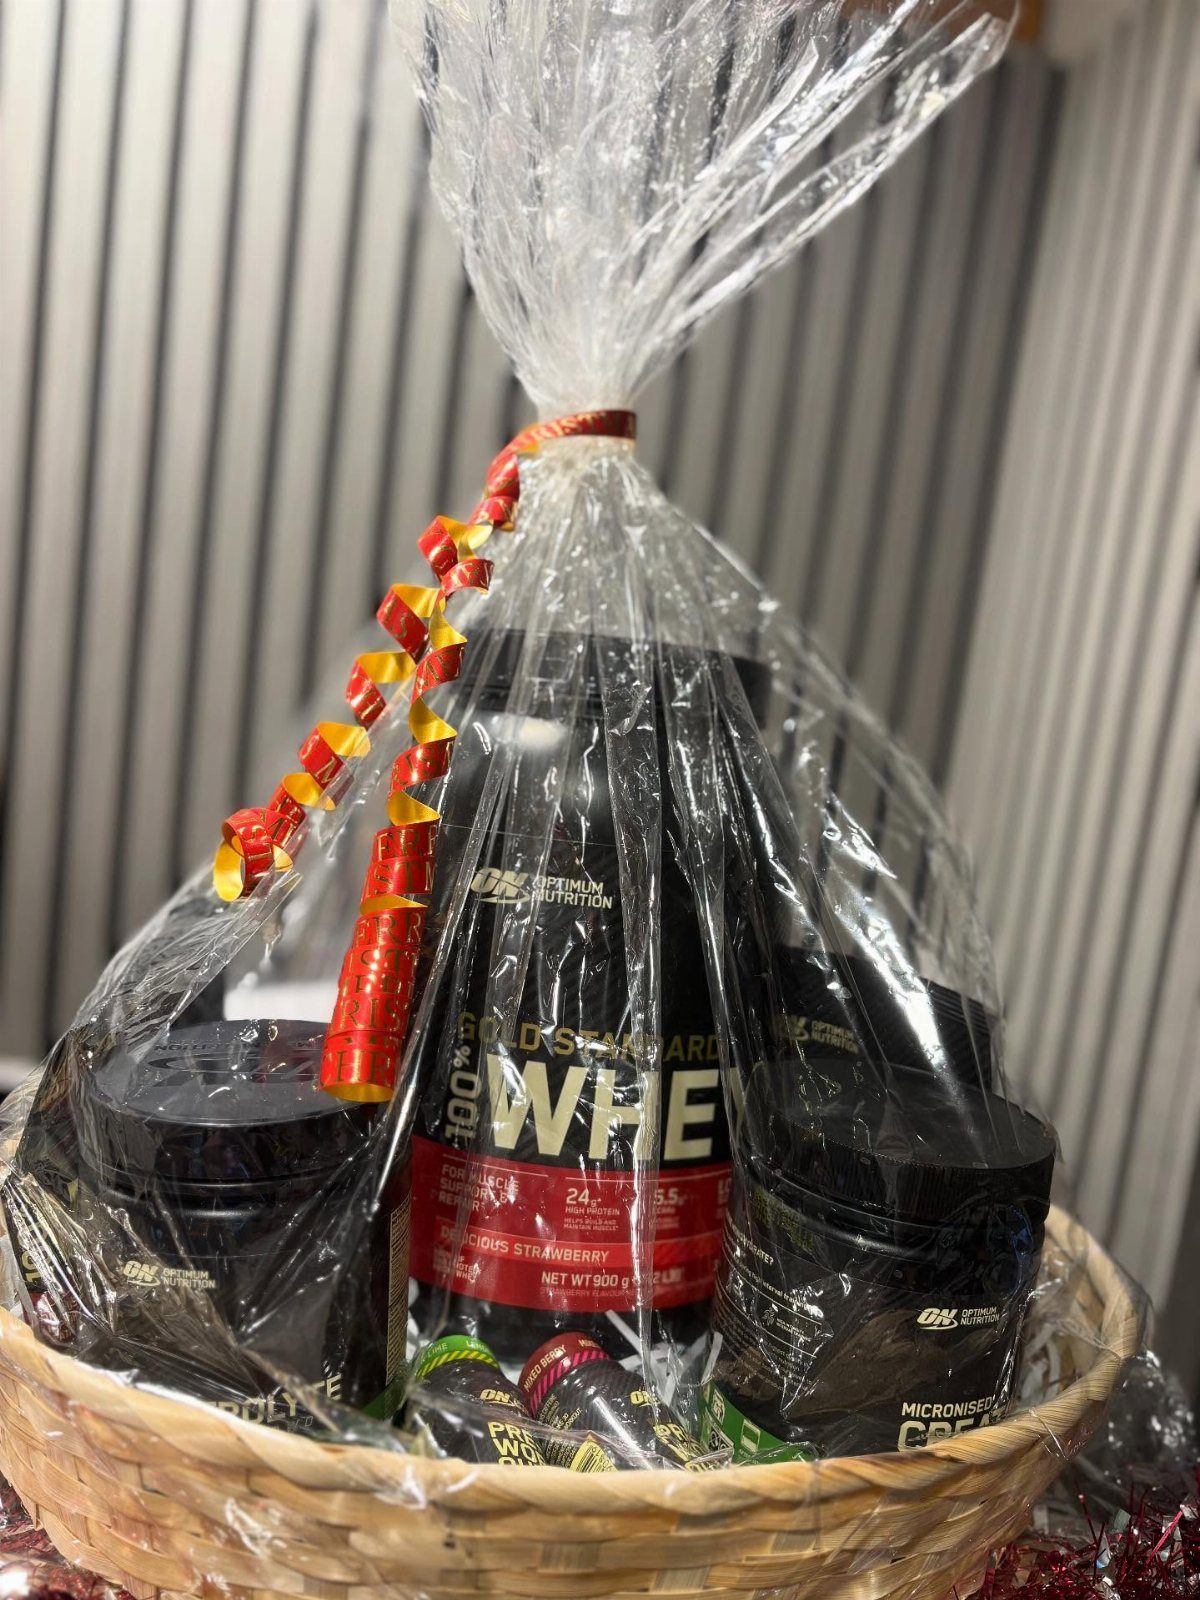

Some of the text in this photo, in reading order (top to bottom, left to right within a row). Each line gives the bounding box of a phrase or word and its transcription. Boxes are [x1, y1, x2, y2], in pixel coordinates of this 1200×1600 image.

[470, 867, 530, 903] ON
[536, 875, 604, 895] OPTIMUM
[533, 890, 613, 910] NUTRITION
[458, 1011, 721, 1062] GOLD STANARD
[444, 1045, 482, 1140] 100%
[441, 1226, 610, 1263] DEICIOUS STRAWBERRY
[123, 1260, 160, 1286] ON
[162, 1267, 209, 1280] OPTIMUM
[162, 1276, 216, 1289] NUTRITION
[541, 1271, 568, 1286] NET
[571, 1274, 592, 1288] WT
[592, 1274, 619, 1288] 900
[916, 1307, 958, 1330] ON
[960, 1314, 1000, 1326] NUTRITION
[961, 1306, 997, 1318] OPTIMUM
[523, 1344, 567, 1393] MIXED BERRY
[480, 1389, 513, 1406] ON
[901, 1396, 993, 1419] MICRONISED
[487, 1420, 535, 1446] PRE
[493, 1437, 548, 1466] WO
